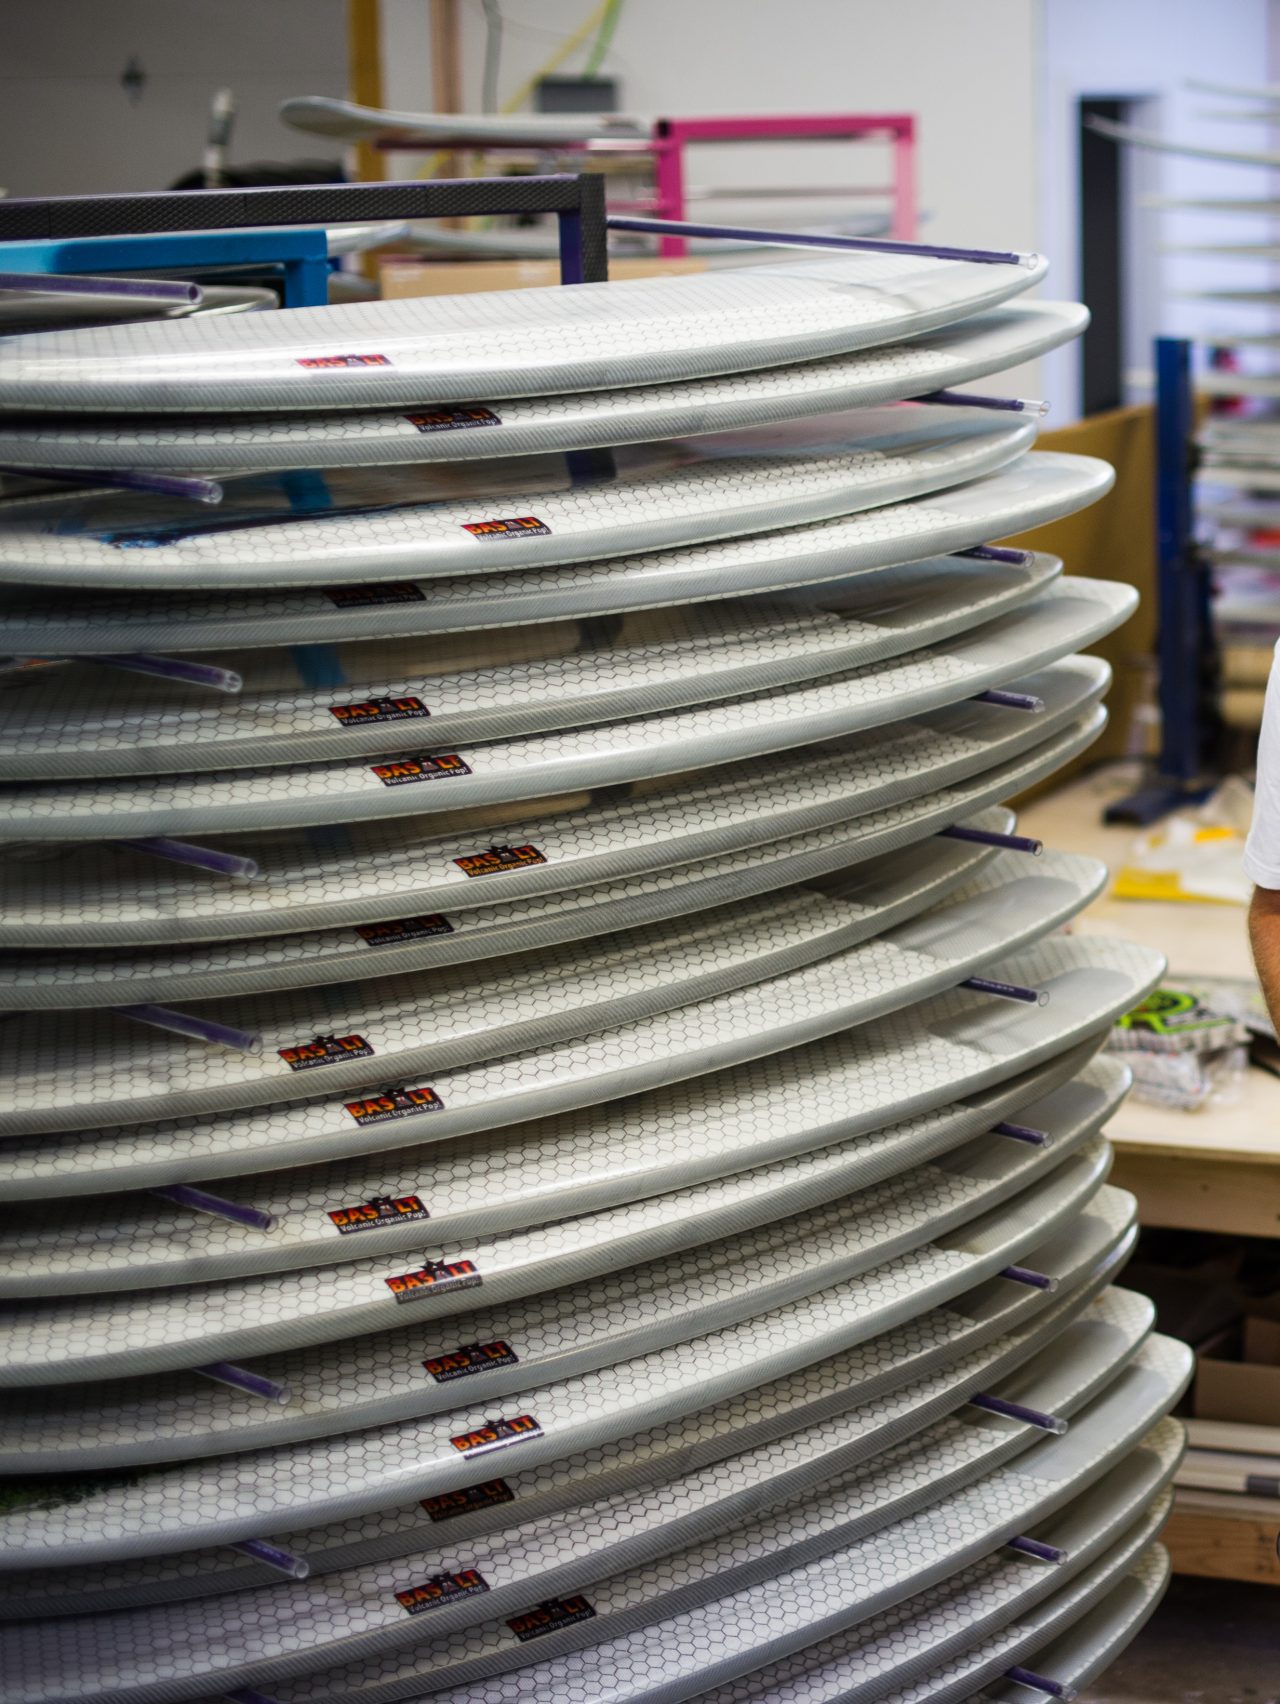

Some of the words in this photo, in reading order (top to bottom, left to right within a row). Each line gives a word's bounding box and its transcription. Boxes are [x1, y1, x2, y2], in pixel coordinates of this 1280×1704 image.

[463, 517, 538, 535] BASALT
[331, 697, 419, 718] BASALT
[374, 755, 461, 778] BASALT
[455, 845, 536, 870] BASALT
[280, 1036, 362, 1062] BASALT
[348, 1089, 435, 1116] BASALT
[357, 1111, 394, 1123] Volcanic
[393, 1105, 424, 1115] Organic
[423, 1100, 440, 1109] Pop!
[330, 1197, 420, 1225] BASALT
[339, 1220, 374, 1231] Volcanic
[405, 1209, 424, 1219] Pop!
[387, 1261, 471, 1294] BASALT
[425, 1342, 507, 1374] BASALT
[453, 1416, 533, 1451] BASALT
[397, 1571, 477, 1606] BASALT
[509, 1596, 585, 1632] BASALT
